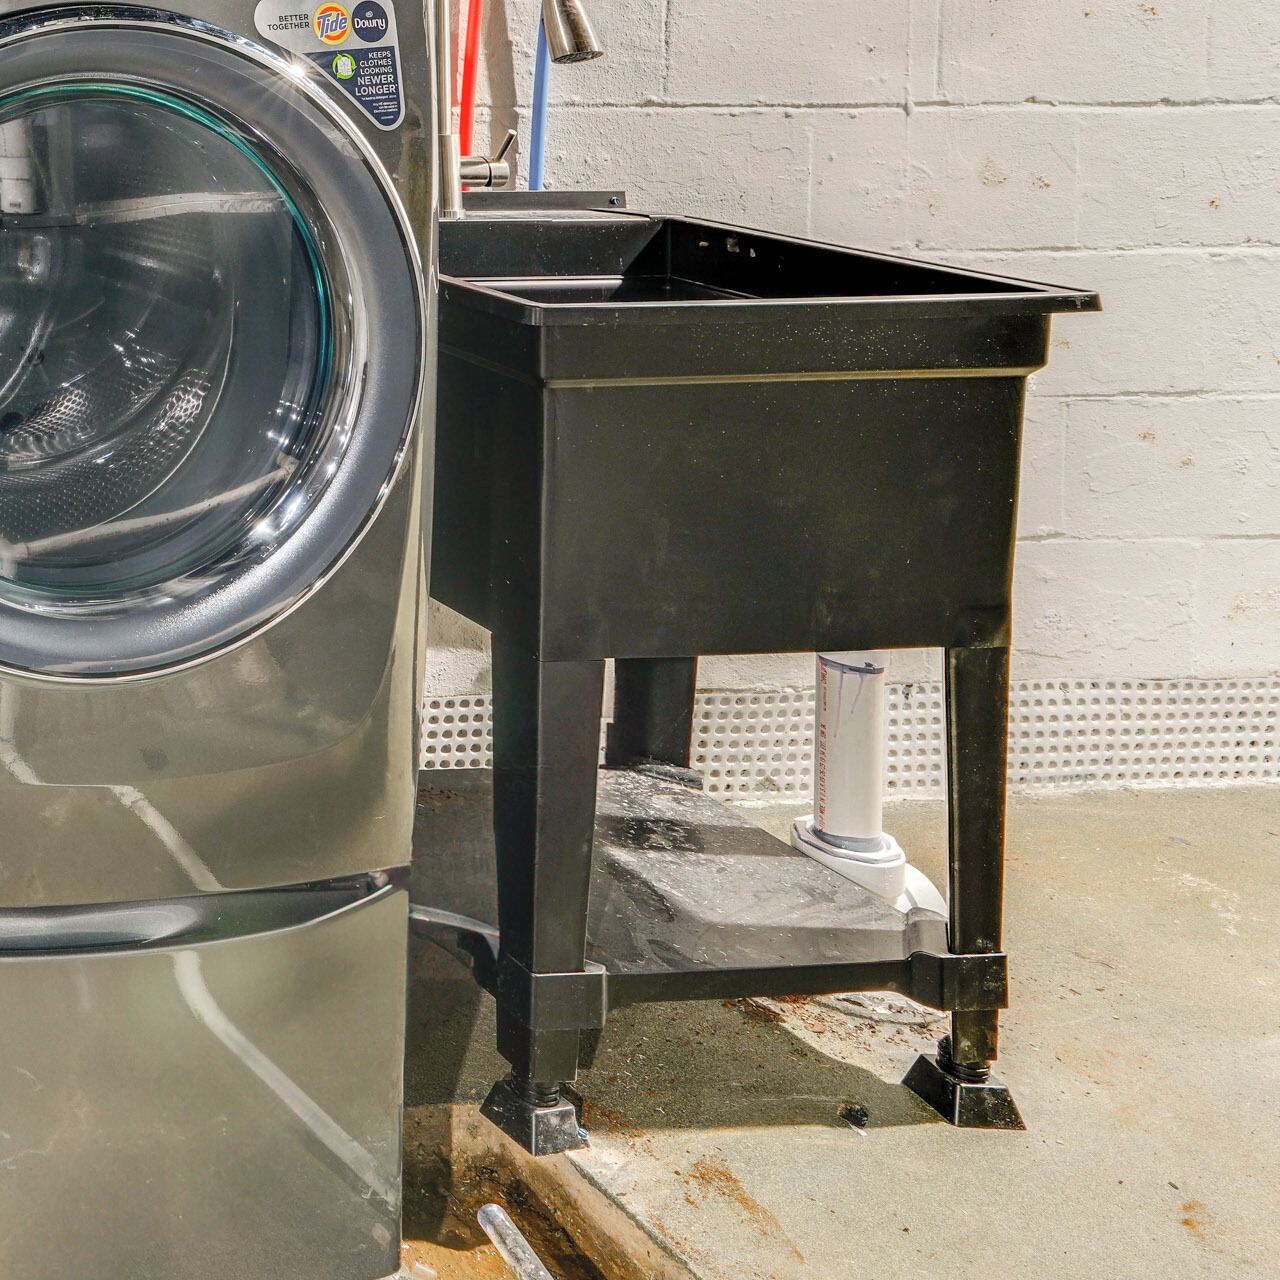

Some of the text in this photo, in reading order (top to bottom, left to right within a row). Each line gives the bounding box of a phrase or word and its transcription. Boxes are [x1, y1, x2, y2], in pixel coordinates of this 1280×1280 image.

[278, 14, 309, 22] BETTER
[267, 21, 310, 31] TOGETHER
[317, 12, 348, 40] Tide
[354, 18, 386, 29] Downy
[368, 51, 391, 59] KEEPS
[360, 59, 392, 67] CLOTHES
[360, 66, 393, 75] LOOKING
[357, 75, 394, 86] NEWER
